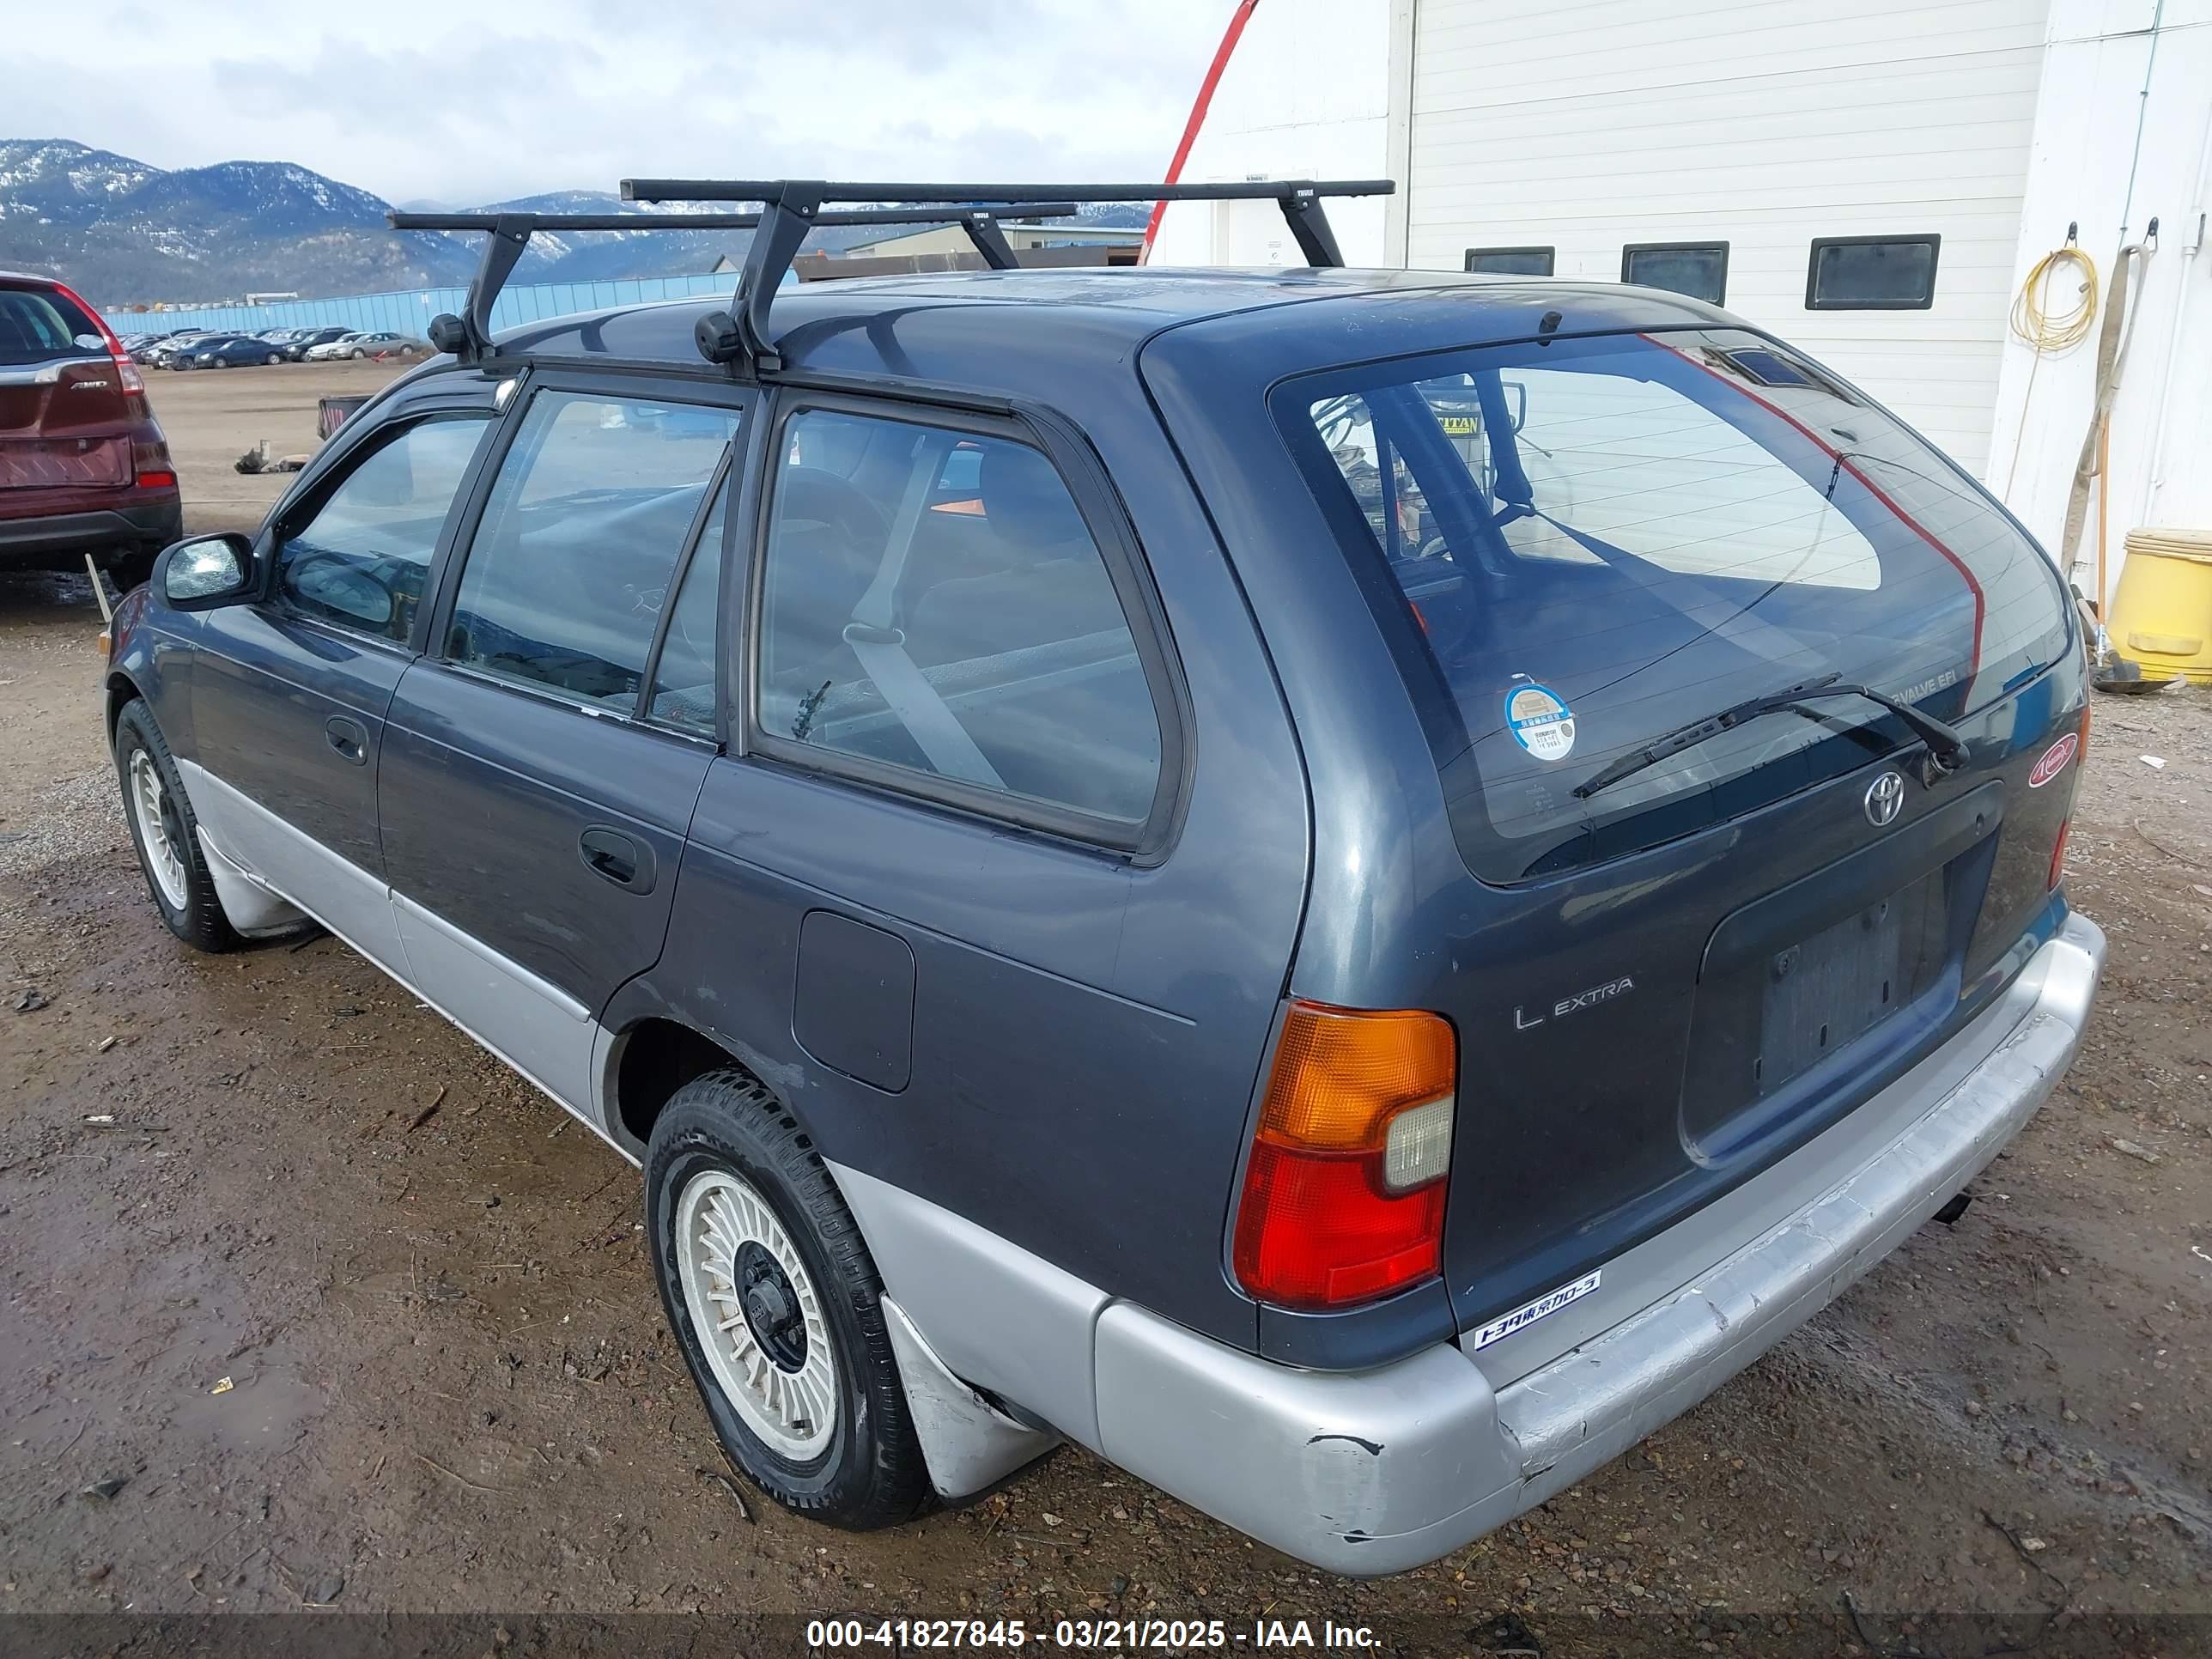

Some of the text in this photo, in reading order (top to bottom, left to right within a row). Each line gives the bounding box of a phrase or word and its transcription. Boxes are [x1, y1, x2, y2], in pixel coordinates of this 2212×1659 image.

[70, 380, 108, 389] AWD
[1938, 669, 1957, 687] EFI
[1516, 977, 1633, 1030] L EXTRA
